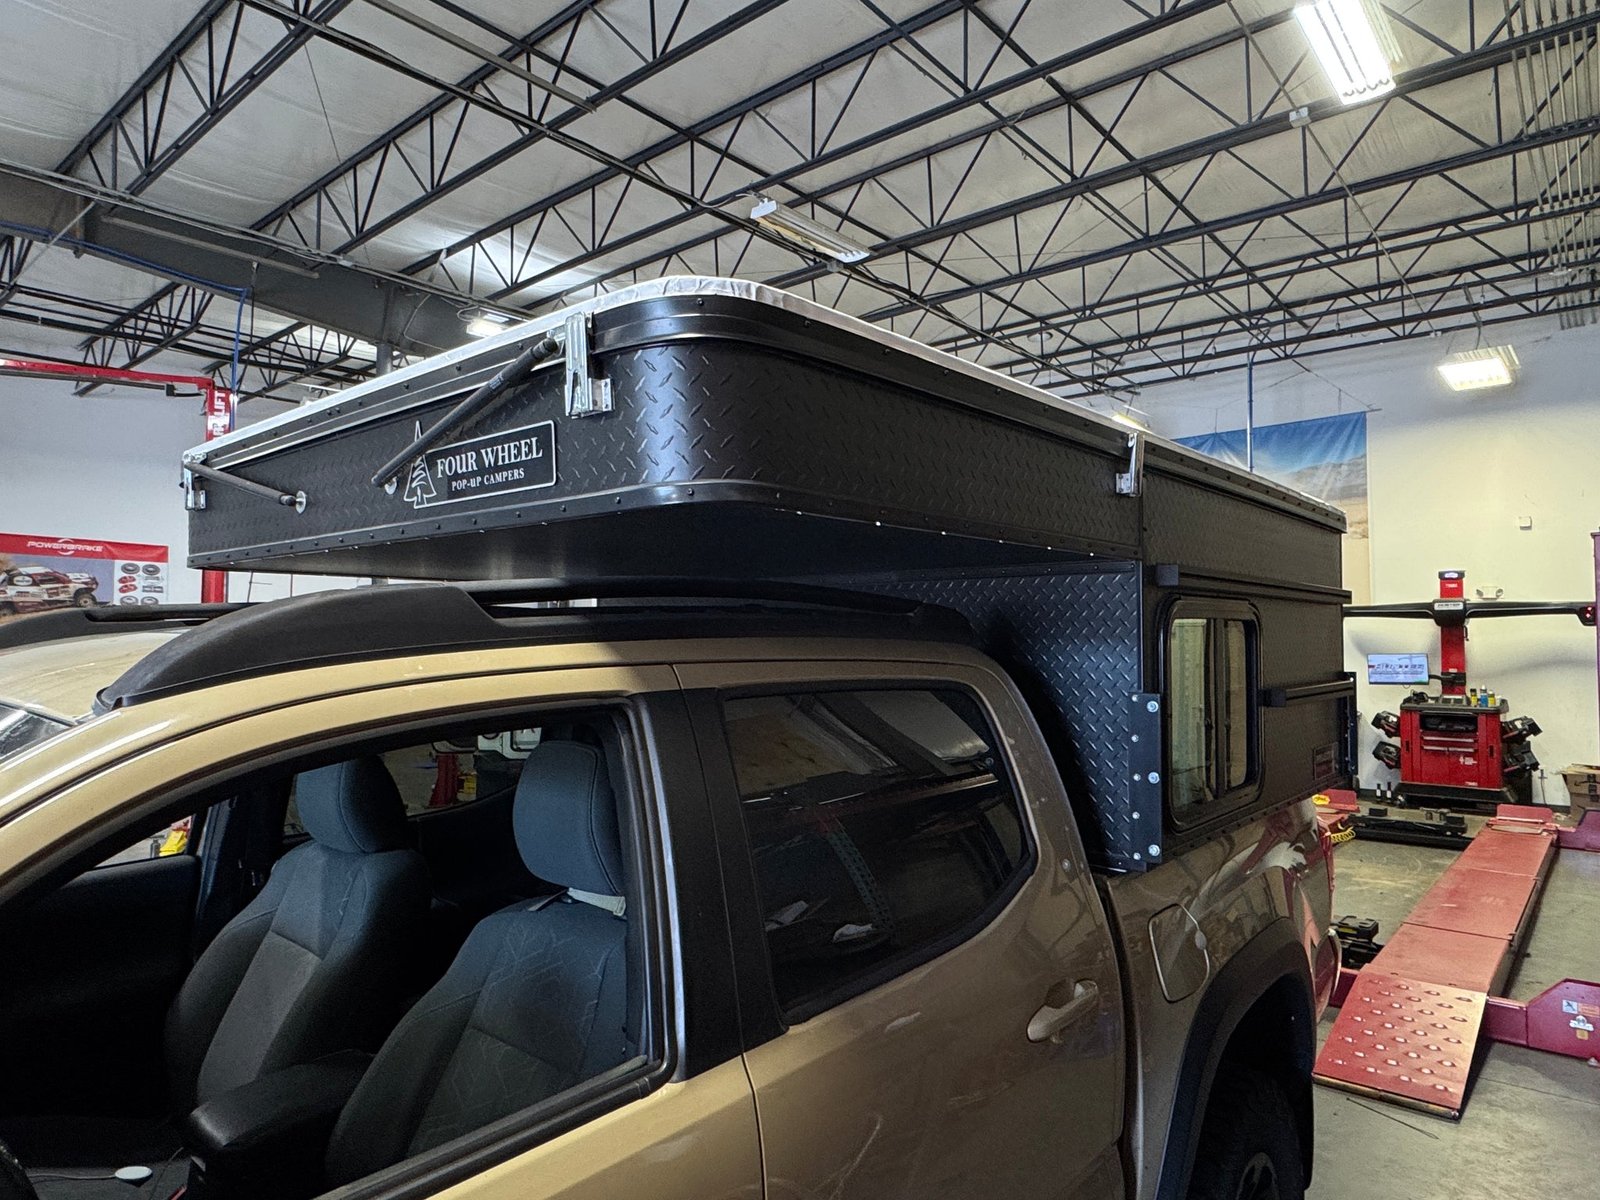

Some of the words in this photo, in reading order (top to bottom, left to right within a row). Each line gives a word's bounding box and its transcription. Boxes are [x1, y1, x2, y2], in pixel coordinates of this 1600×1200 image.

[214, 391, 226, 417] LIFT
[437, 451, 478, 478] FOUR
[480, 437, 543, 467] WHEEL
[451, 475, 482, 491] POP-UP
[484, 467, 525, 484] CAMPERS
[27, 540, 104, 552] POWERBRAKE
